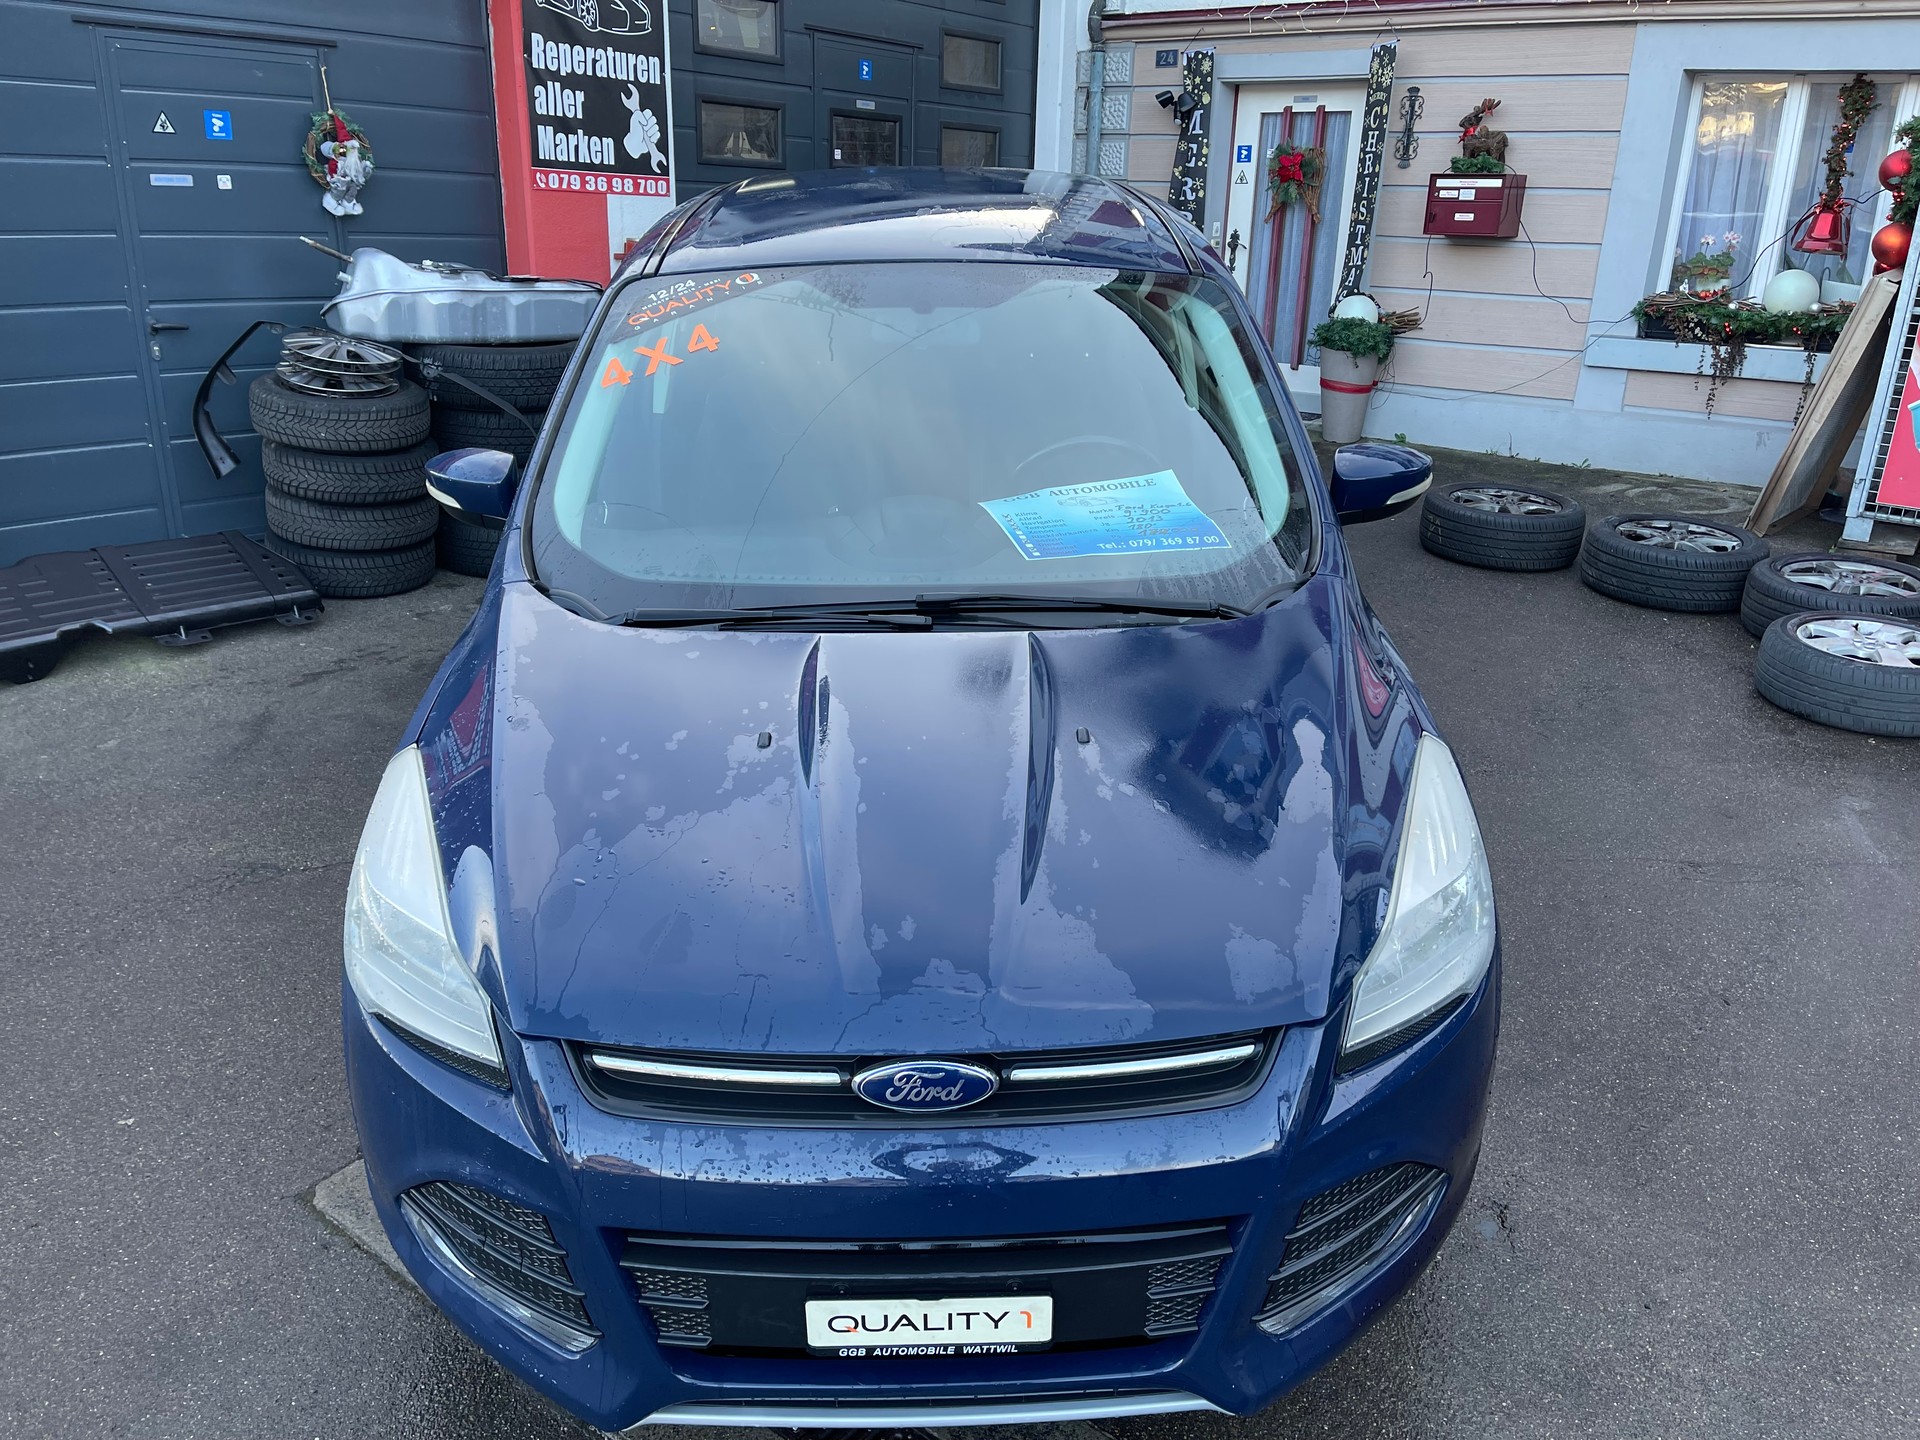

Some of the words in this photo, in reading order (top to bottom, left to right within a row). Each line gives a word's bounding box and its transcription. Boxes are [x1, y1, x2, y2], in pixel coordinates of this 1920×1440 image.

[531, 32, 661, 84] Reperaturen
[1159, 52, 1174, 65] 24
[534, 81, 585, 119] aller
[1369, 92, 1388, 104] MERRY
[537, 125, 615, 165] Marken
[549, 173, 581, 190] 079
[585, 175, 608, 192] 36
[612, 177, 634, 193] 98
[637, 178, 667, 194] 700
[648, 279, 696, 301] 12/24
[627, 279, 731, 325] QUALITY
[1049, 478, 1157, 497] AUTOMOBILE
[1160, 537, 1182, 546] 369
[1186, 536, 1199, 545] 87
[1204, 535, 1219, 543] 00
[885, 1071, 965, 1102] Ford
[827, 1311, 1010, 1333] QUALITY
[838, 1348, 866, 1357] GGB
[873, 1346, 955, 1356] AUTOMOBILE
[962, 1345, 1018, 1354] WATTWIL
